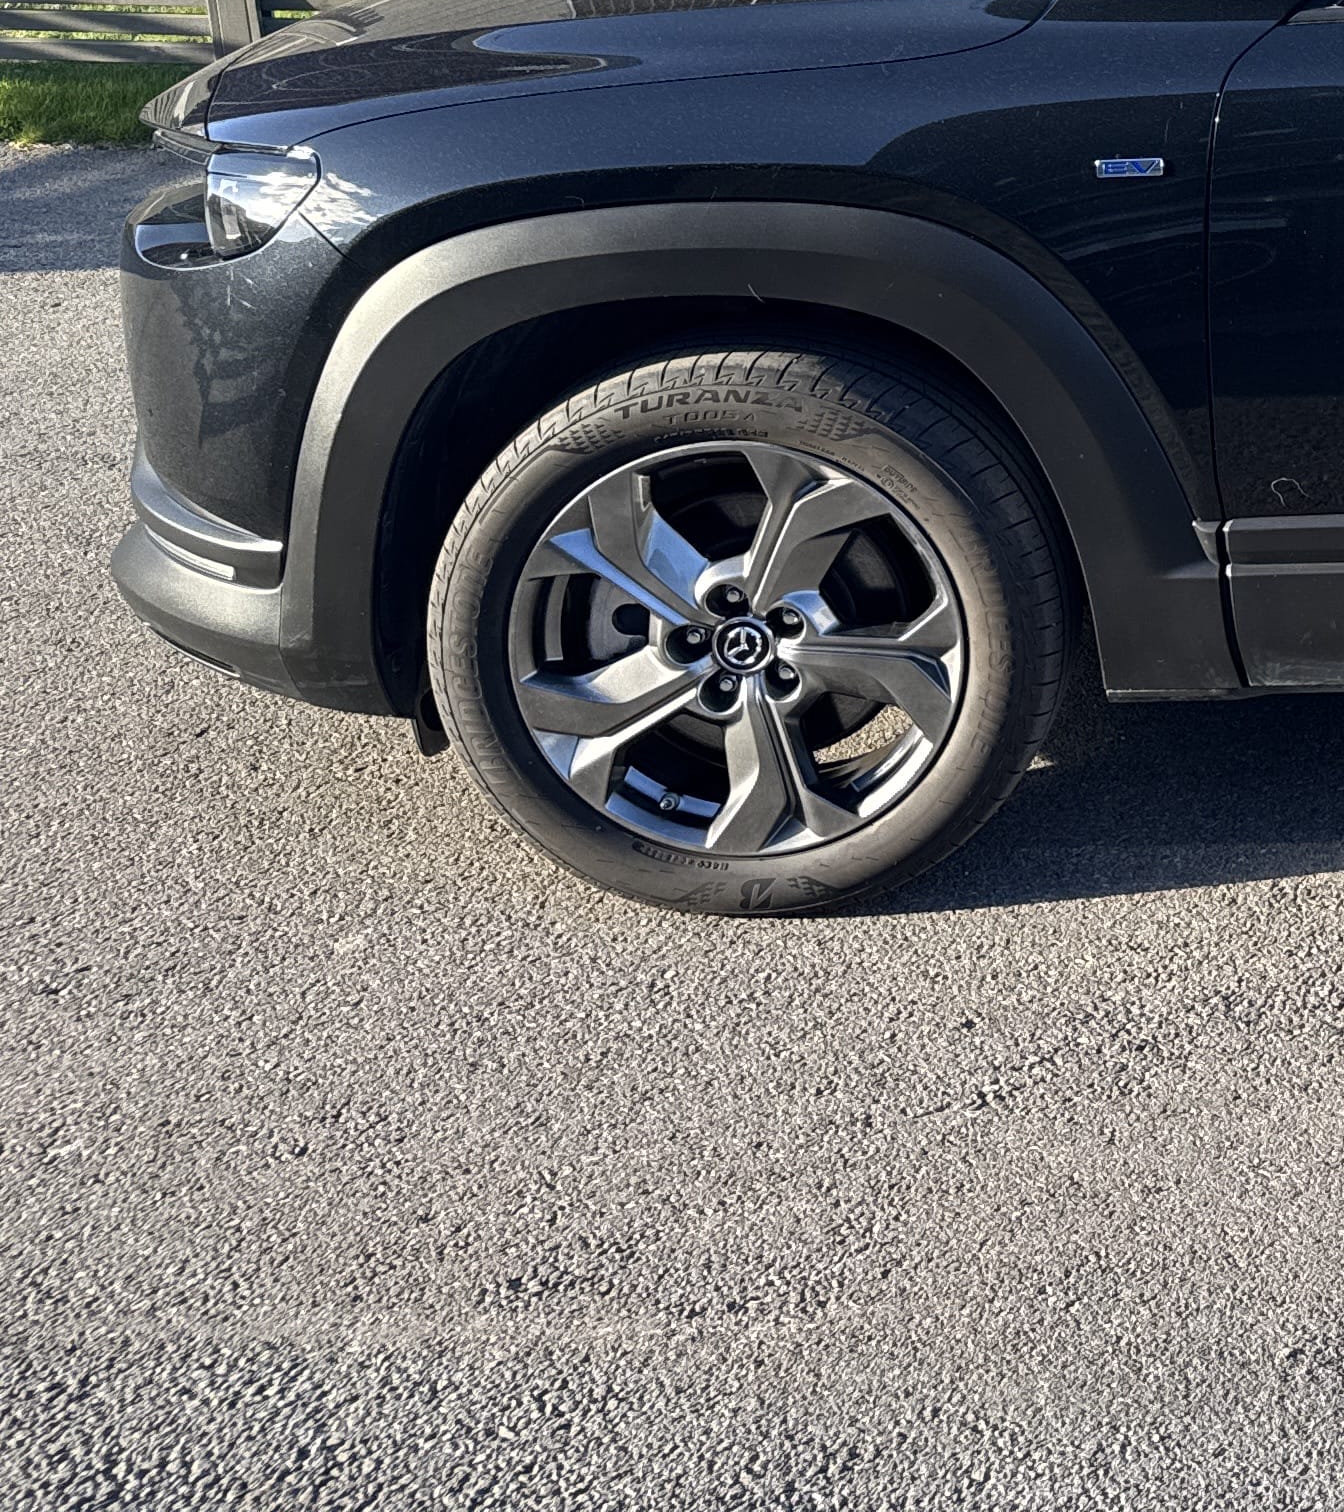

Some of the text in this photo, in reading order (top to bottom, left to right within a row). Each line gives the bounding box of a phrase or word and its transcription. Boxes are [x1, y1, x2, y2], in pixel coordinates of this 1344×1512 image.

[1100, 159, 1161, 177] EV
[614, 388, 802, 420] TURANZA
[451, 542, 521, 785] BRIDGESTONE
